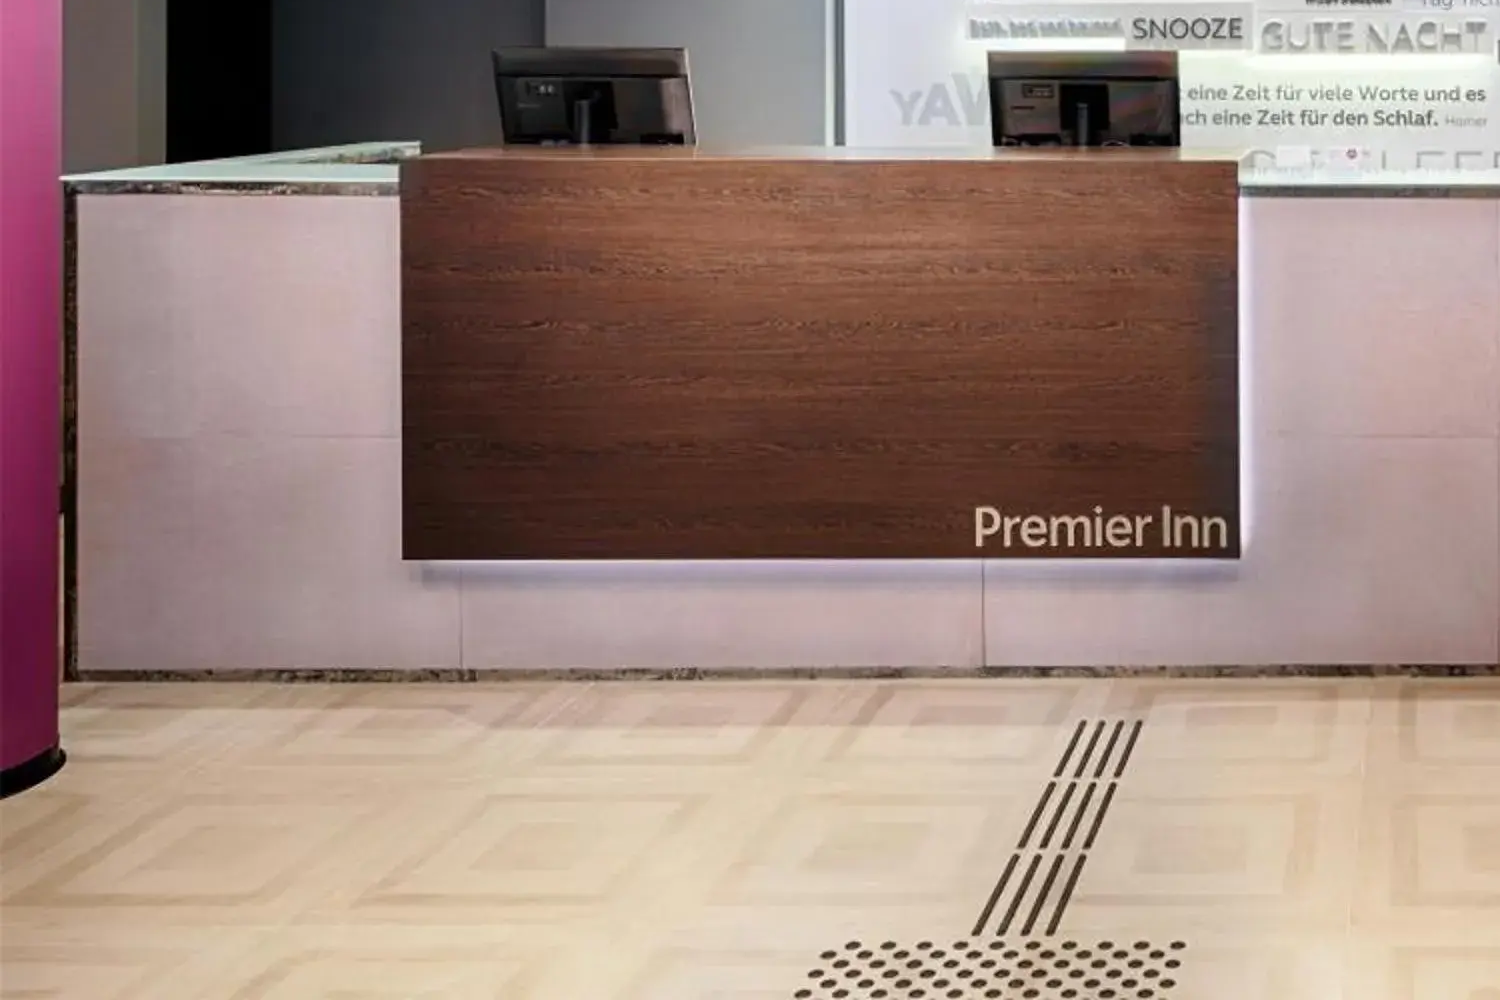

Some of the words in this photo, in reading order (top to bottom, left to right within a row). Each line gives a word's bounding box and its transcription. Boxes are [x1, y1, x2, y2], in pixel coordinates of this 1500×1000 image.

[1132, 18, 1243, 40] SNOOZE
[1261, 22, 1354, 53] GUTE
[1366, 21, 1487, 53] NACHT
[1187, 86, 1227, 101] eine
[1232, 86, 1270, 101] Zeit
[1276, 84, 1301, 101] für
[1308, 85, 1353, 101] viele
[1359, 85, 1419, 101] Worte
[1424, 85, 1461, 101] und
[1465, 89, 1486, 101] es
[1212, 112, 1251, 126] eine
[1257, 110, 1294, 126] Zeit
[1300, 109, 1327, 126] für
[1333, 110, 1368, 126] den
[1374, 110, 1438, 127] Schlaf.
[975, 506, 1152, 548] Premier
[1162, 505, 1227, 548] Inn
